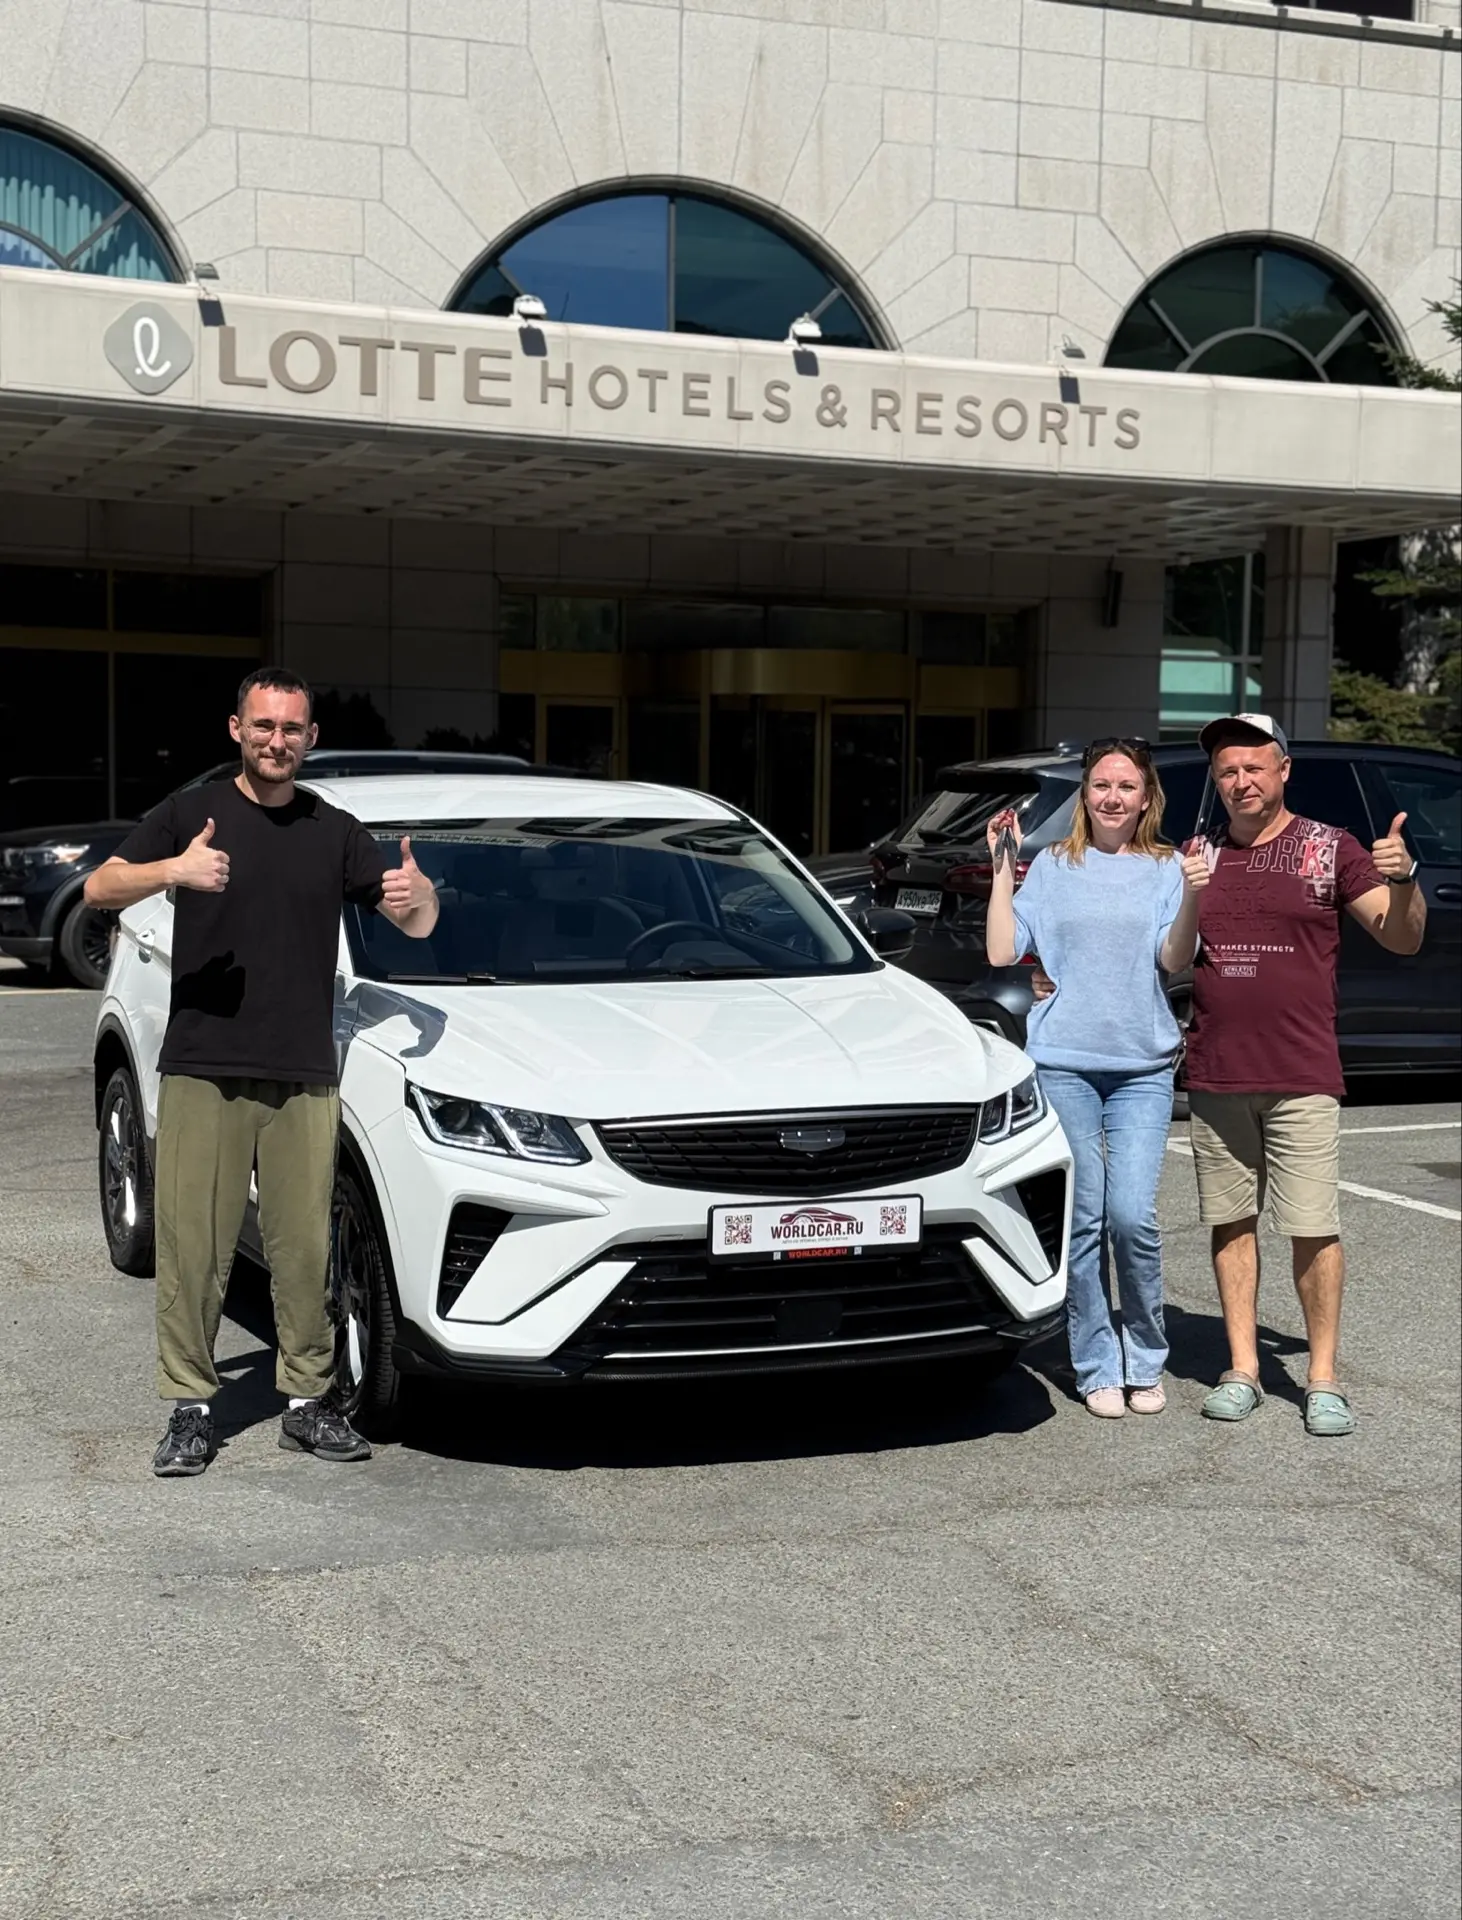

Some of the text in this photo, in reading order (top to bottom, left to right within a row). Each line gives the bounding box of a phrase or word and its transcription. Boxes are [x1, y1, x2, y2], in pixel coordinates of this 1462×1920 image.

[218, 325, 1141, 450] LOTTE HOTELS & RESORTS
[1220, 944, 1248, 952] MAKES
[1250, 944, 1295, 953] STRENGTH
[771, 1220, 864, 1240] WORLDCAR.RU
[788, 1248, 848, 1260] WORLDCAR.RU
